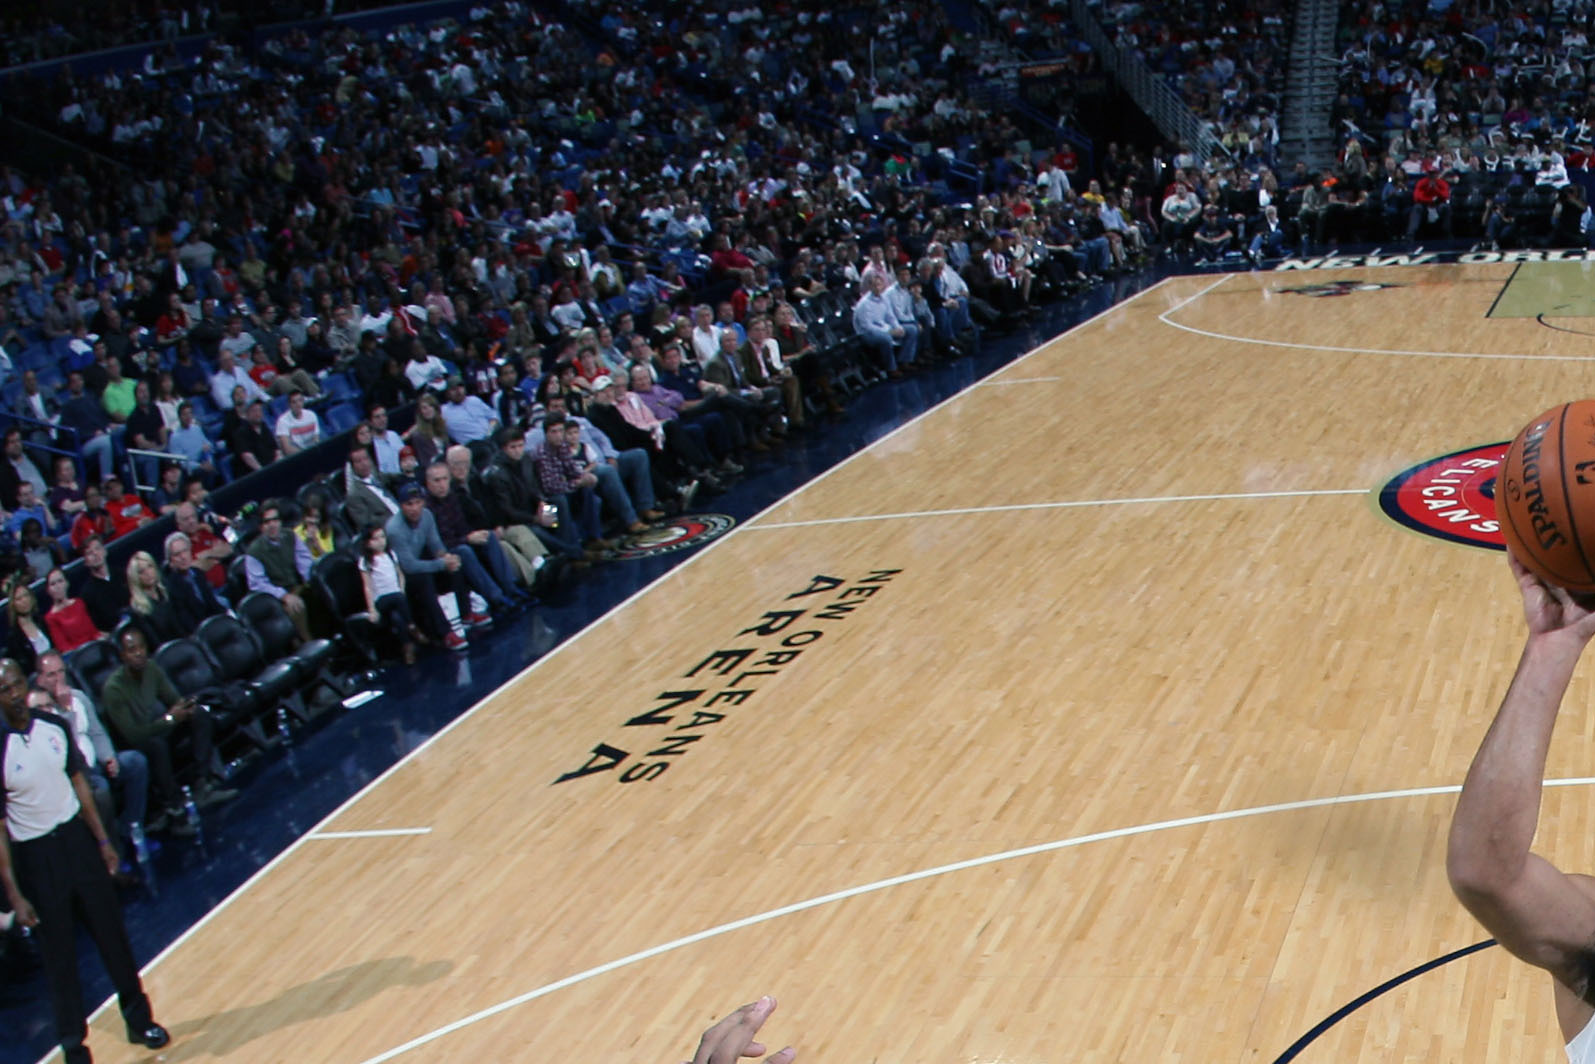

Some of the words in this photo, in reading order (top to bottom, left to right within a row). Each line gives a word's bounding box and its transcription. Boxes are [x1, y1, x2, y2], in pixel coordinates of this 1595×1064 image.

[1275, 253, 1434, 271] NEW
[1421, 454, 1506, 534] ELICANS
[1522, 417, 1569, 552] SPALDING
[812, 567, 904, 621] NEW
[550, 573, 847, 787] ARENA
[617, 629, 825, 785] ORLEANS
